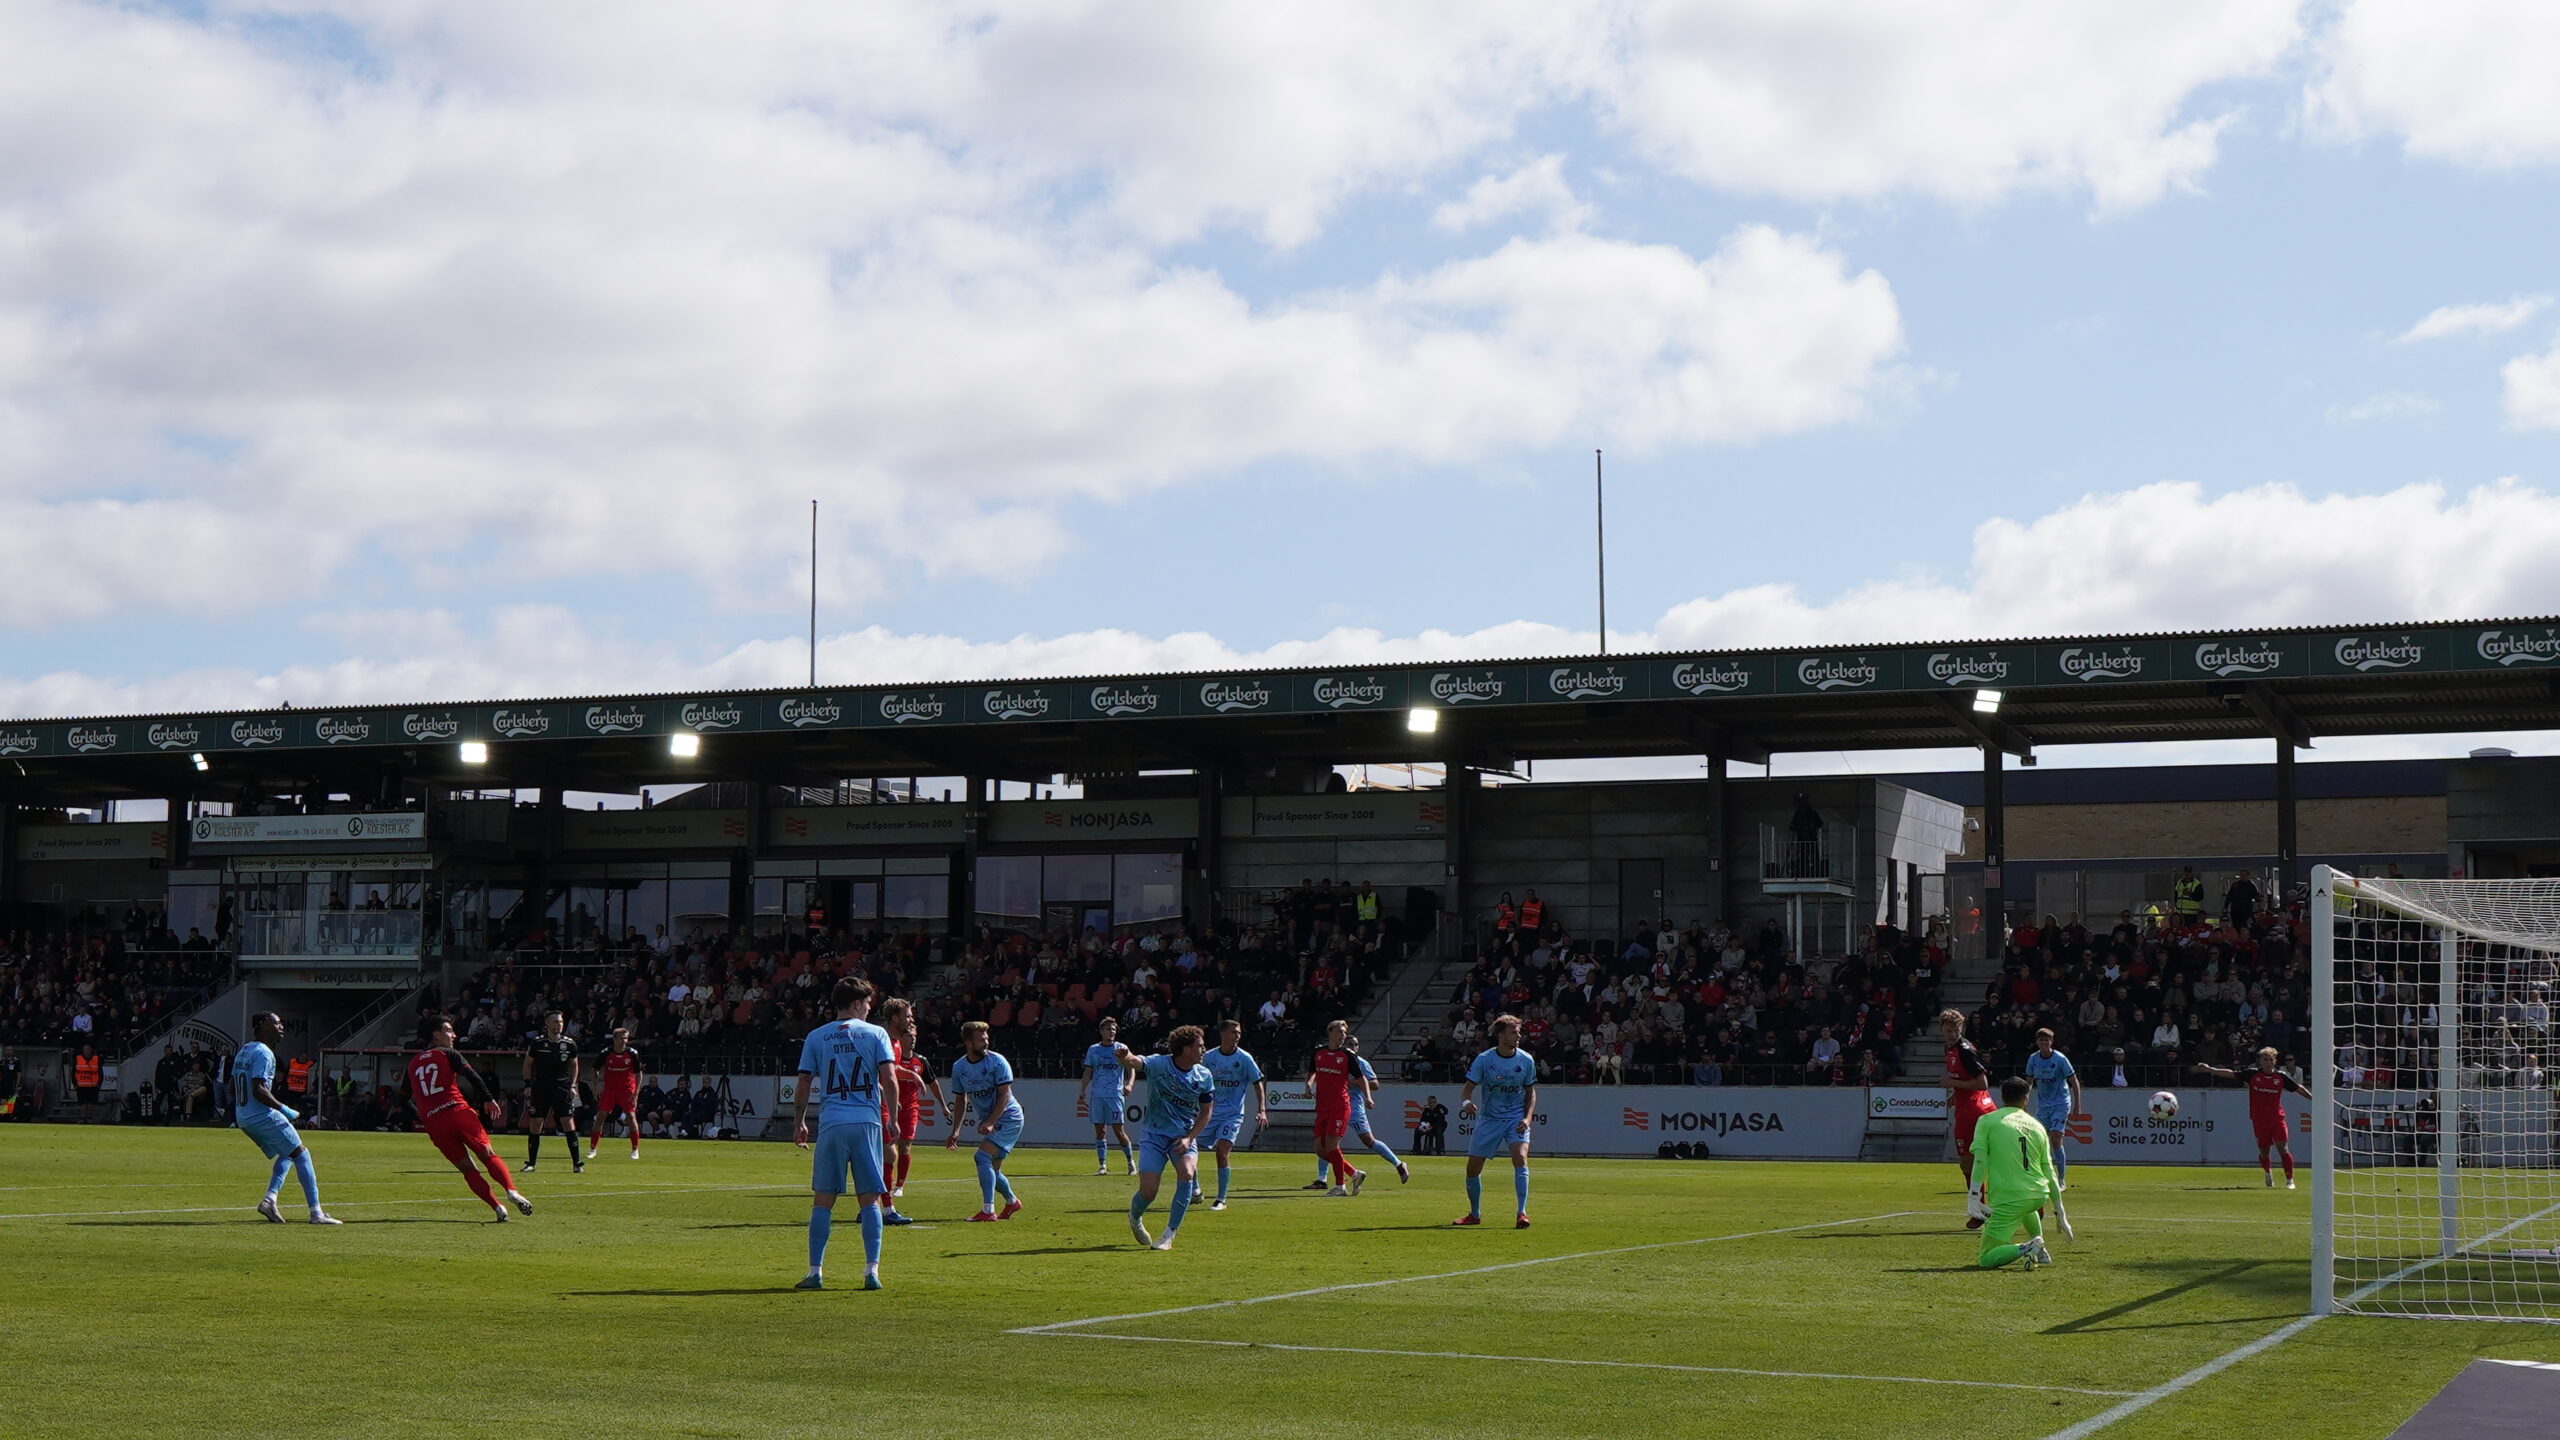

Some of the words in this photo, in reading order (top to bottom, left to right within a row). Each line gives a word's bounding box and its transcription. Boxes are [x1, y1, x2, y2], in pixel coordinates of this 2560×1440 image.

[2060, 647, 2141, 681] Carlsberg
[2196, 642, 2279, 676] Carlsberg
[2335, 637, 2420, 671] Carlsberg
[1673, 663, 1747, 695] Carlsberg
[1799, 658, 1875, 690] Carlsberg
[1928, 653, 2006, 685] Carlsberg
[1201, 682, 1268, 712] Carlsberg
[1314, 677, 1383, 708] Carlsberg
[1430, 672, 1501, 704] Carlsberg
[1550, 668, 1623, 699] Carlsberg
[780, 700, 839, 727] Carlsberg
[881, 694, 942, 723] Carlsberg
[984, 690, 1047, 719] Carlsberg
[1091, 686, 1156, 716] Carlsberg
[316, 717, 368, 744] Carlsberg
[404, 714, 457, 740] Carlsberg
[493, 710, 548, 737] Carlsberg
[586, 706, 643, 734] Carlsberg
[681, 703, 741, 731] Carlsberg
[0, 730, 36, 755] rlsberg
[68, 727, 115, 752] Carlsberg
[149, 724, 197, 749] Carlsberg
[232, 720, 282, 746] Carlsberg
[846, 822, 870, 830] Proud
[872, 821, 906, 831] Sponsor
[908, 820, 930, 829] Since
[932, 820, 952, 828] 2009
[1070, 812, 1153, 830] MONJASA
[1256, 813, 1282, 822] Proud
[1286, 812, 1322, 823] Sponsor
[1324, 812, 1348, 820] Since
[1352, 811, 1374, 819] 2009
[1710, 860, 1718, 871] M
[1988, 854, 1996, 866] M
[2284, 849, 2288, 860] L
[1201, 869, 1207, 880] N
[1448, 864, 1455, 876] N
[367, 974, 393, 983] PARK
[182, 1026, 190, 1038] FC
[416, 1063, 444, 1096] 12
[826, 1056, 874, 1100] 44
[1888, 1098, 1946, 1108] Crossbridge
[1222, 1126, 1228, 1136] 6
[1662, 1112, 1784, 1137] MONJASA
[2109, 1116, 2128, 1128] Oil
[2133, 1116, 2144, 1128] &
[2109, 1132, 2146, 1144] Since
[2150, 1133, 2185, 1144] 2002
[2018, 1136, 2029, 1172] 1
